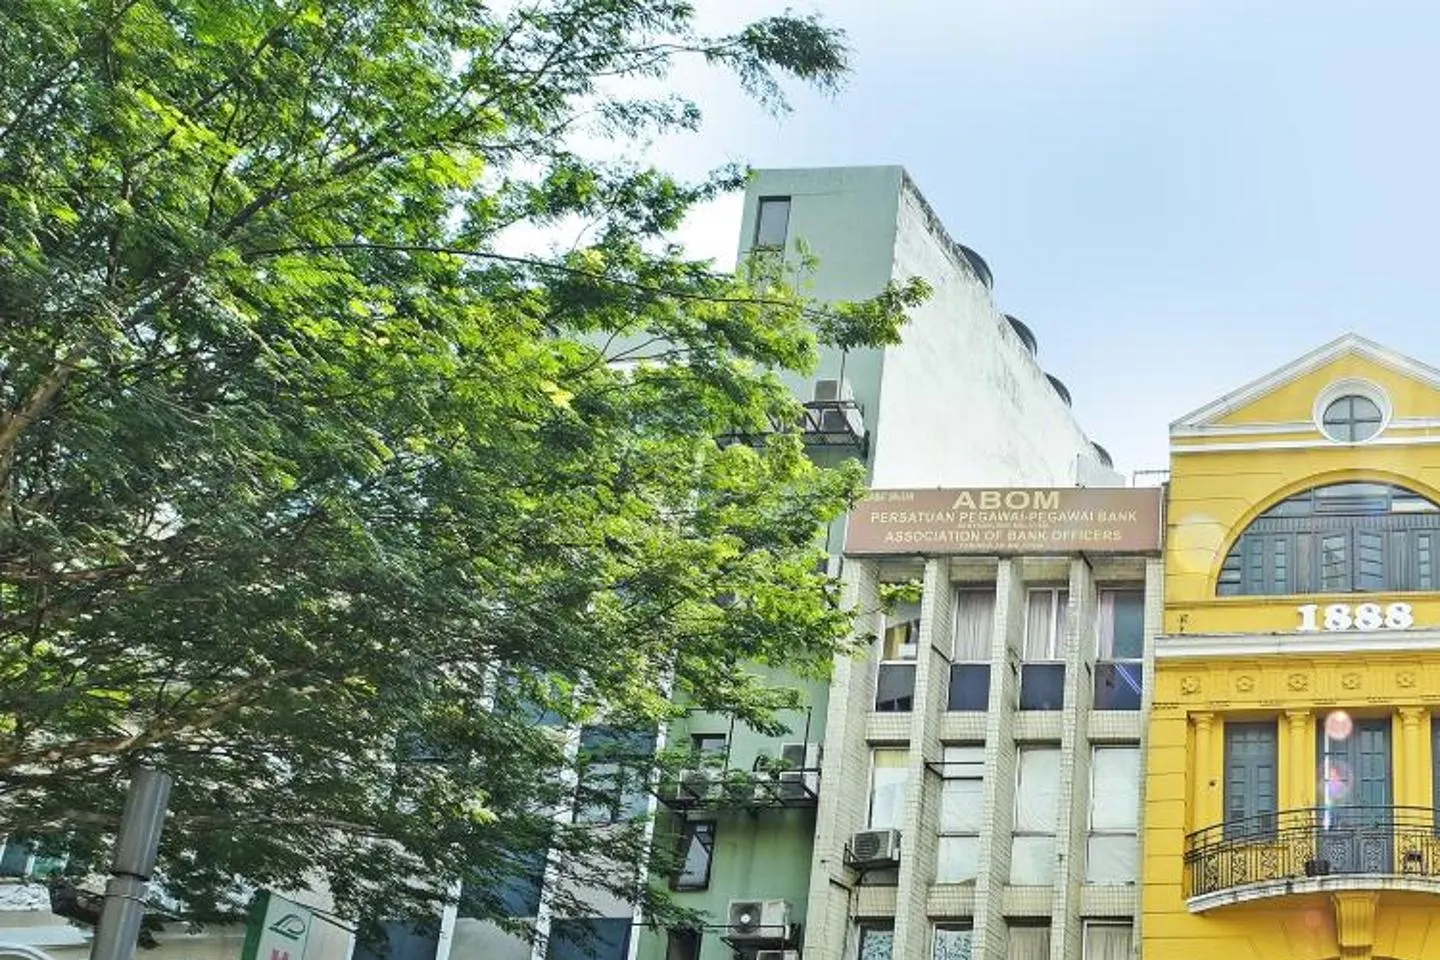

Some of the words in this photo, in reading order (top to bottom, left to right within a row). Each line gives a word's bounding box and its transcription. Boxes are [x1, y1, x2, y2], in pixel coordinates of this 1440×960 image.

[951, 490, 1061, 510] ABOM
[870, 511, 955, 524] PERSATUAN
[1097, 510, 1137, 522] BANK
[884, 530, 980, 543] ASSOCIATION
[984, 530, 1002, 542] OF
[1007, 530, 1048, 542] BANK
[1051, 529, 1122, 541] OFFICERS
[1296, 602, 1414, 631] 1888
